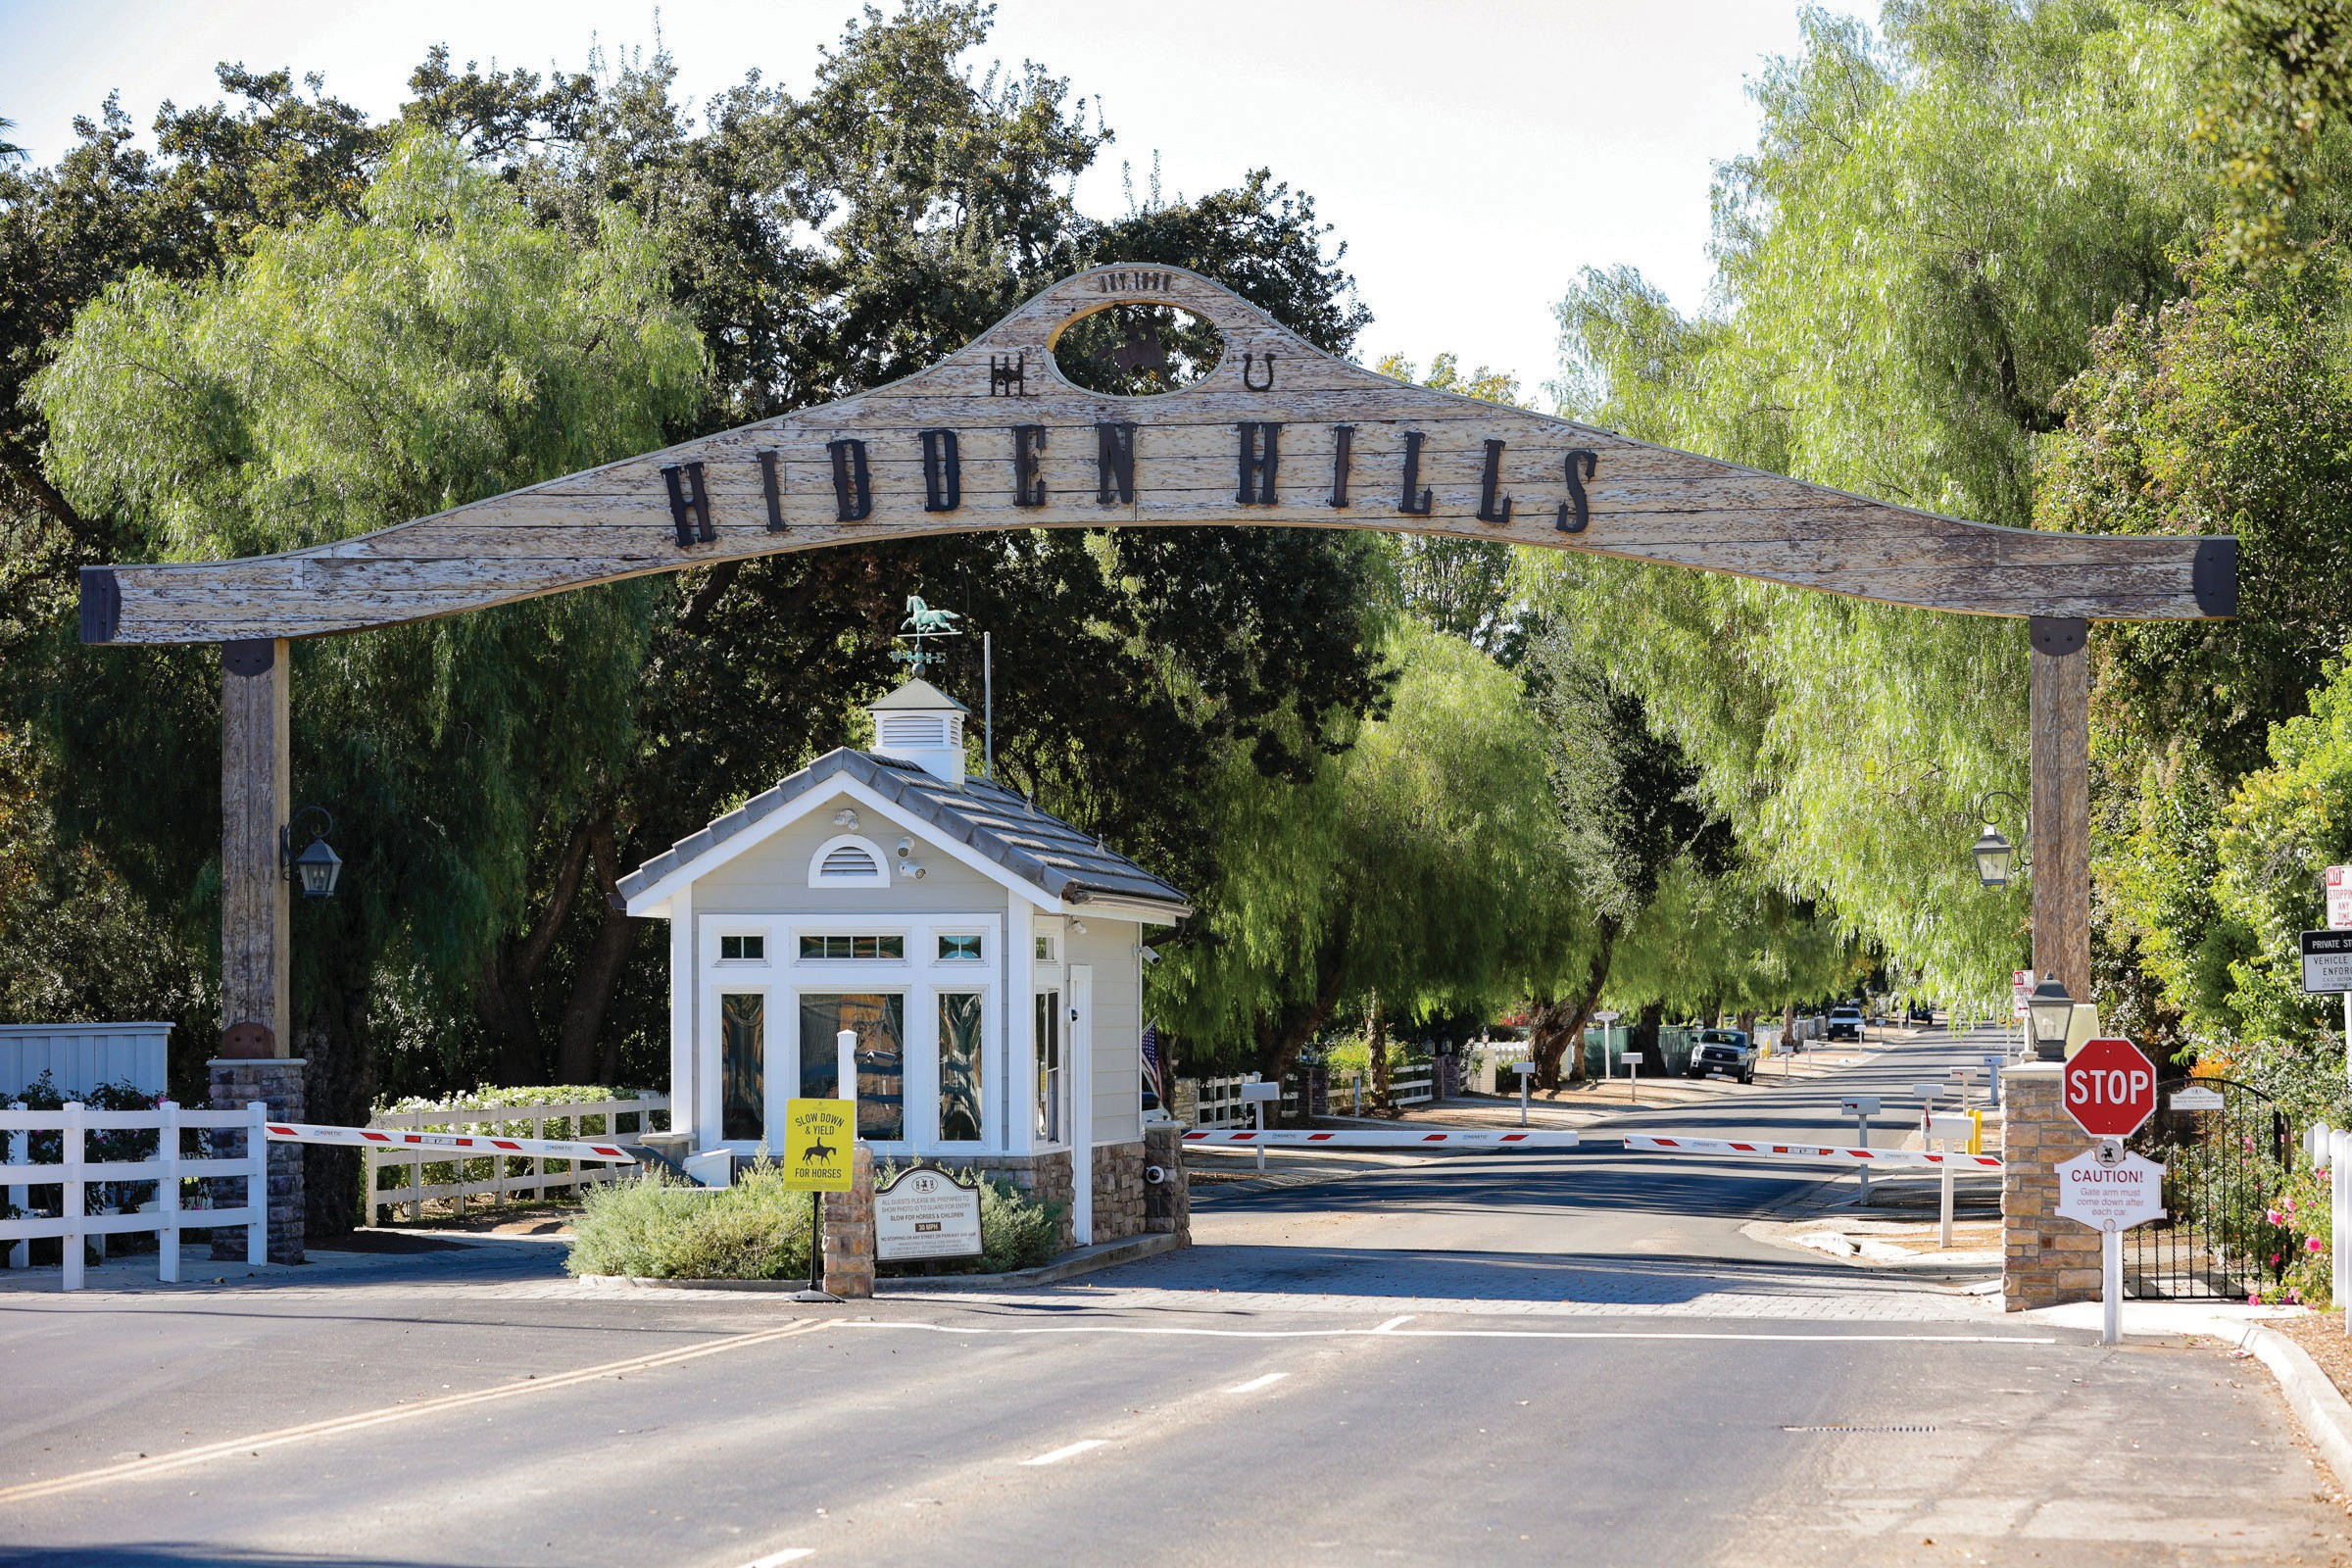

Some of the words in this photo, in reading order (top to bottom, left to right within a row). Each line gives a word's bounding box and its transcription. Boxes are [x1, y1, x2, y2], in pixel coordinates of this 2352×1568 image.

[660, 420, 1138, 547] HIDDEN
[1235, 421, 1597, 534] HILLS
[2328, 869, 2338, 883] NO
[2312, 940, 2340, 949] PRIVATE
[2070, 1069, 2149, 1104] STOP
[795, 1113, 818, 1127] SLOW
[820, 1112, 845, 1128] DOWN
[805, 1126, 810, 1135] &
[813, 1125, 835, 1135] YIELD
[795, 1168, 809, 1178] FOR
[811, 1168, 842, 1179] HORSES
[2072, 1169, 2143, 1183] CAUTION!
[2081, 1188, 2100, 1197] Gate
[2101, 1198, 2124, 1206] down
[2126, 1198, 2144, 1206] after
